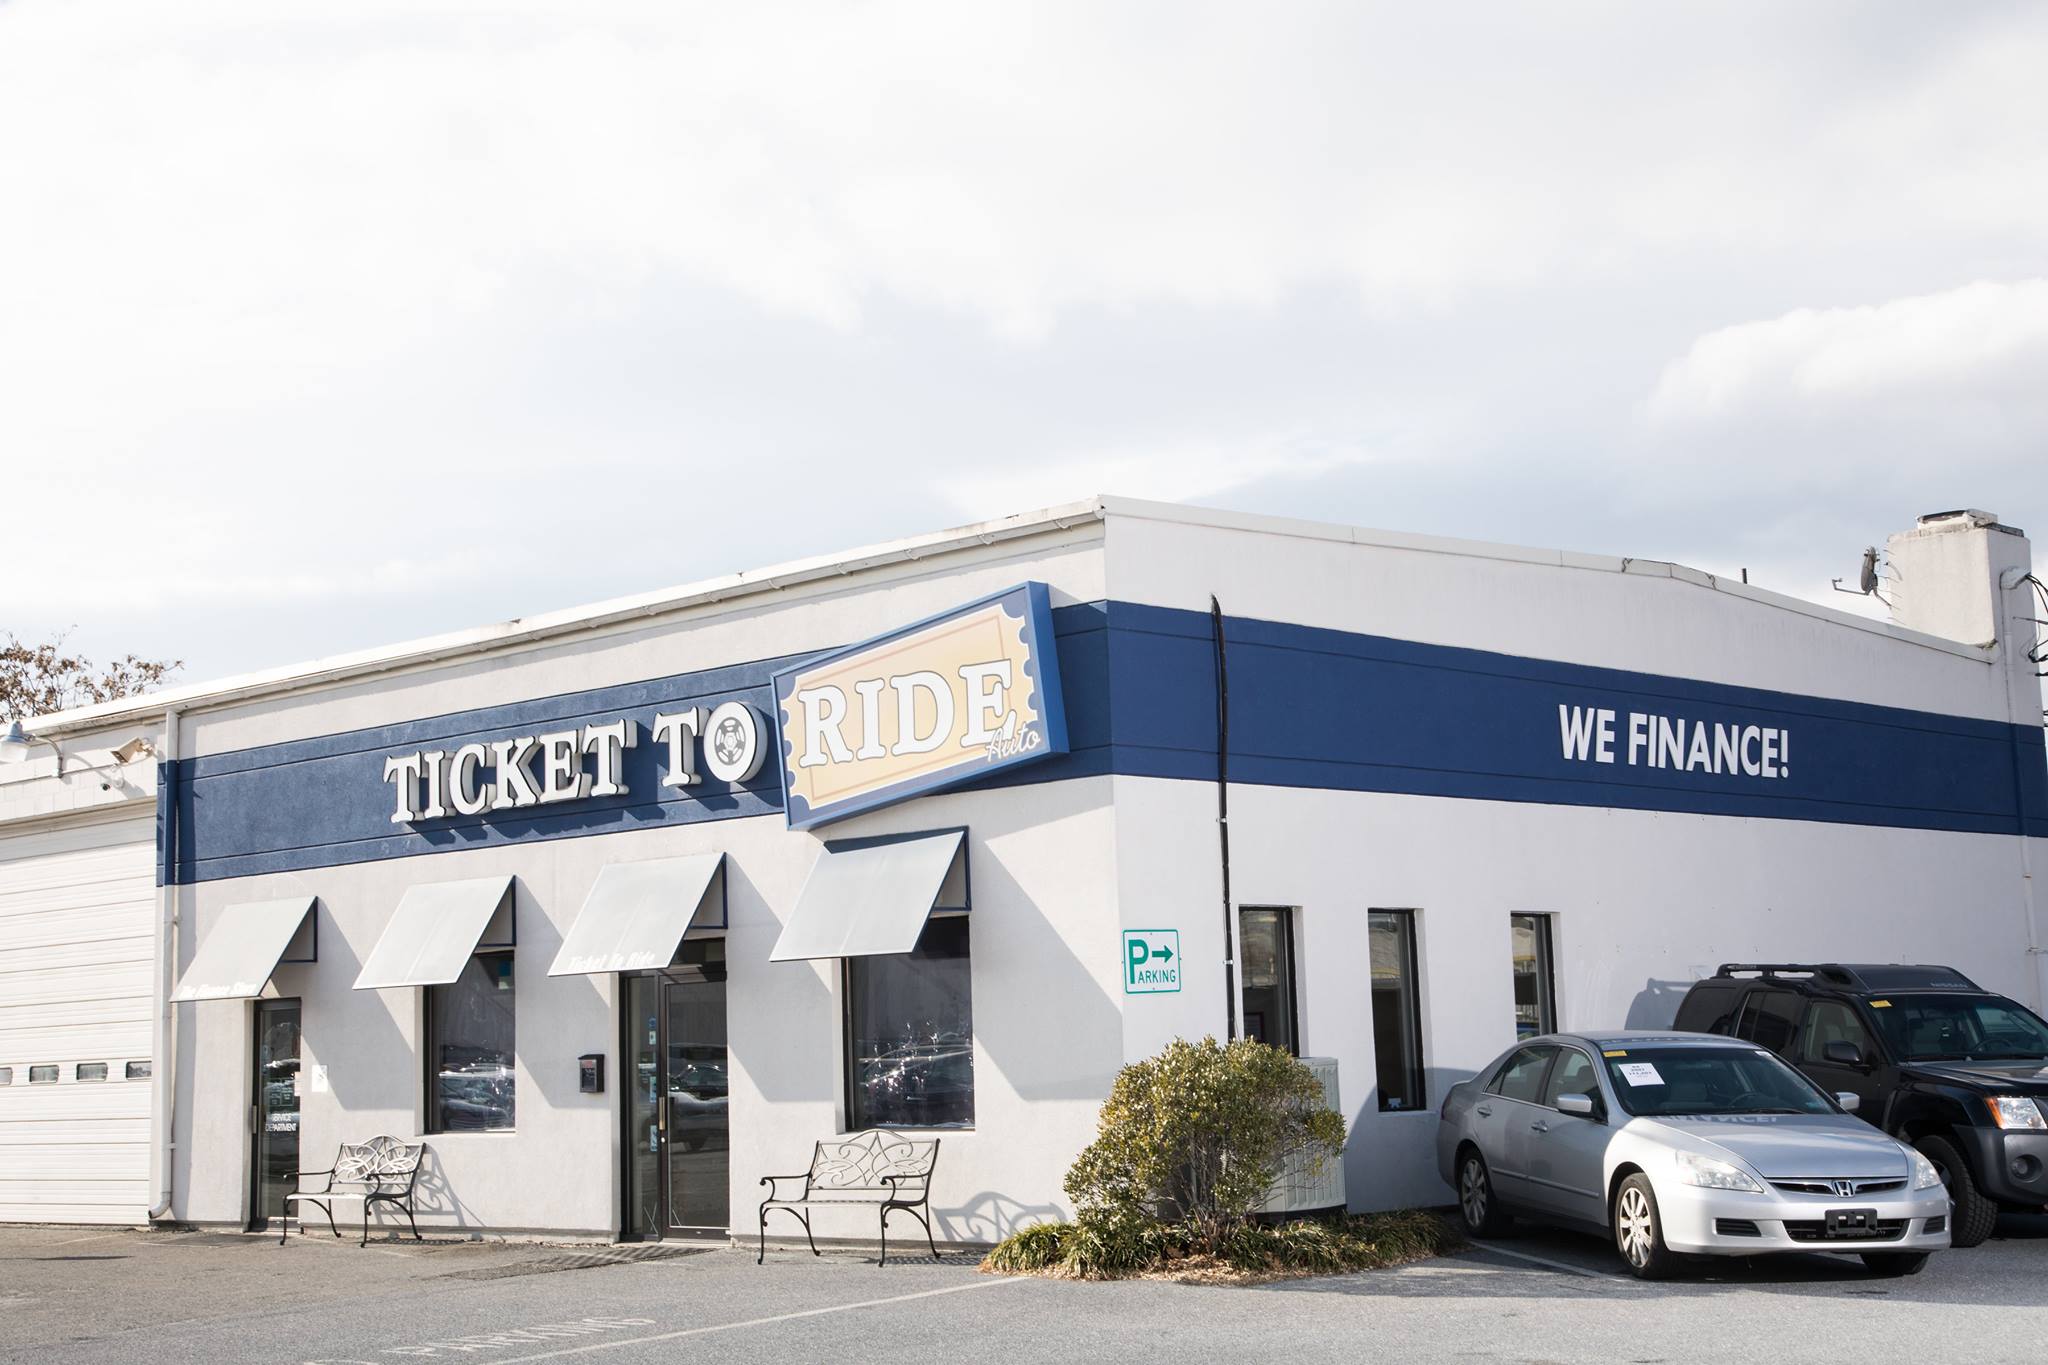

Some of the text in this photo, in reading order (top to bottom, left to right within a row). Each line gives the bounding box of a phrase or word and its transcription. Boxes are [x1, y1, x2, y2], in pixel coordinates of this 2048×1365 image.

[797, 658, 1017, 768] RIDE
[985, 721, 1041, 763] Auto
[1559, 704, 1789, 778] WE FINANCE!
[382, 701, 767, 823] TICKET TO
[567, 954, 607, 970] Ticket
[627, 950, 656, 967] Ride
[1128, 939, 1176, 984] PARKING
